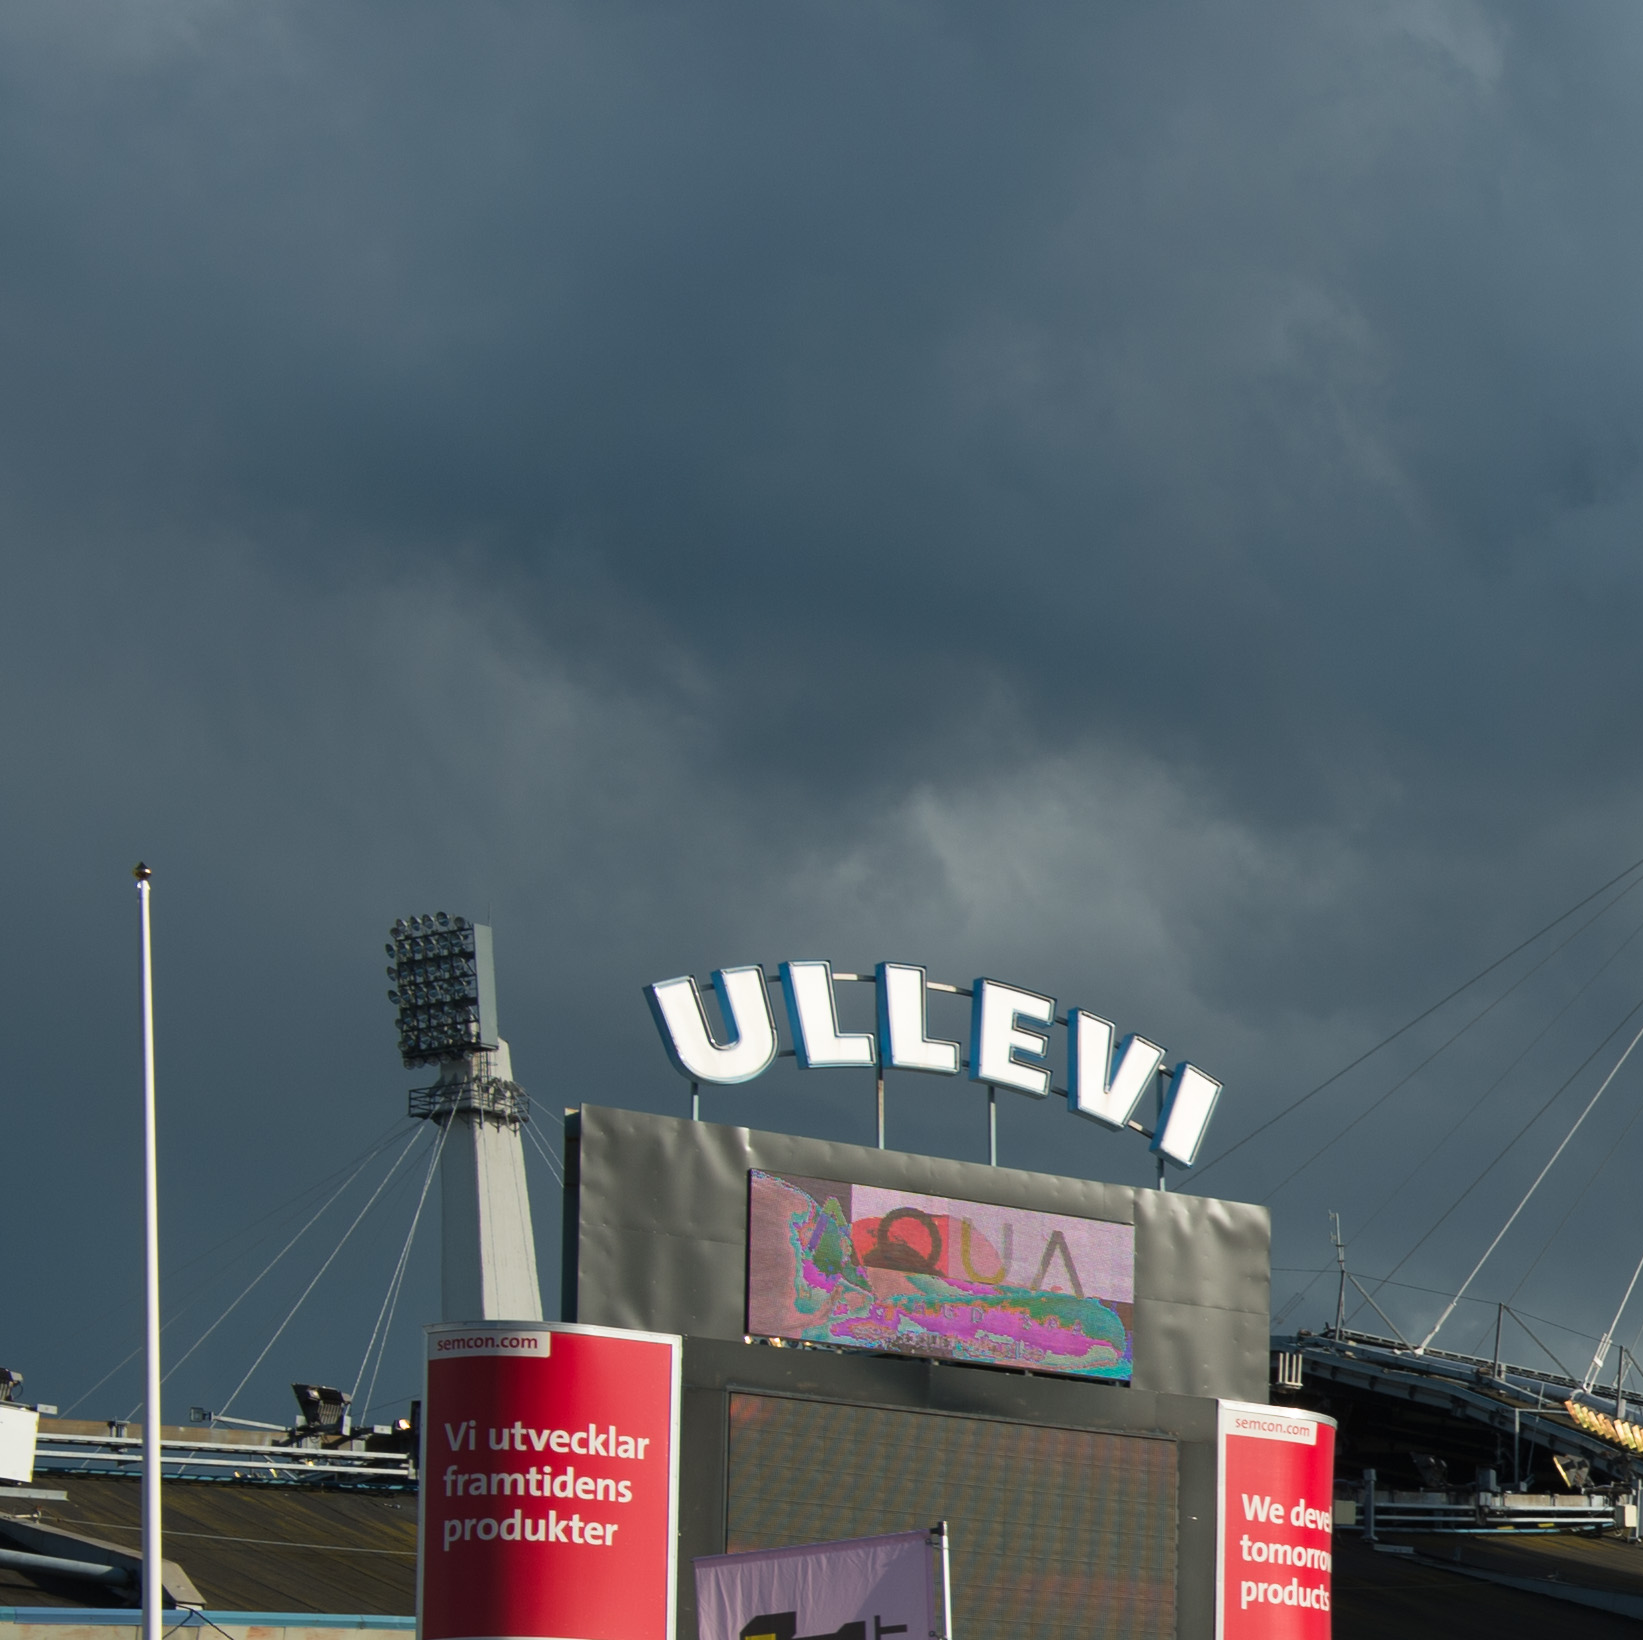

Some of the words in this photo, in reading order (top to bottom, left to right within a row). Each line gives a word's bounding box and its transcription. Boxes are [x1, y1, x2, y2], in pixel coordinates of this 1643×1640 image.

[642, 960, 1225, 1170] ULLEVI
[436, 1335, 538, 1352] semcon.com
[444, 1420, 477, 1451] Vi
[488, 1421, 650, 1460] utvecklar
[1235, 1417, 1311, 1437] semcon.com
[443, 1465, 634, 1503] framtidens
[1241, 1493, 1285, 1524] We
[443, 1509, 619, 1552] produkter
[1240, 1578, 1331, 1612] products
